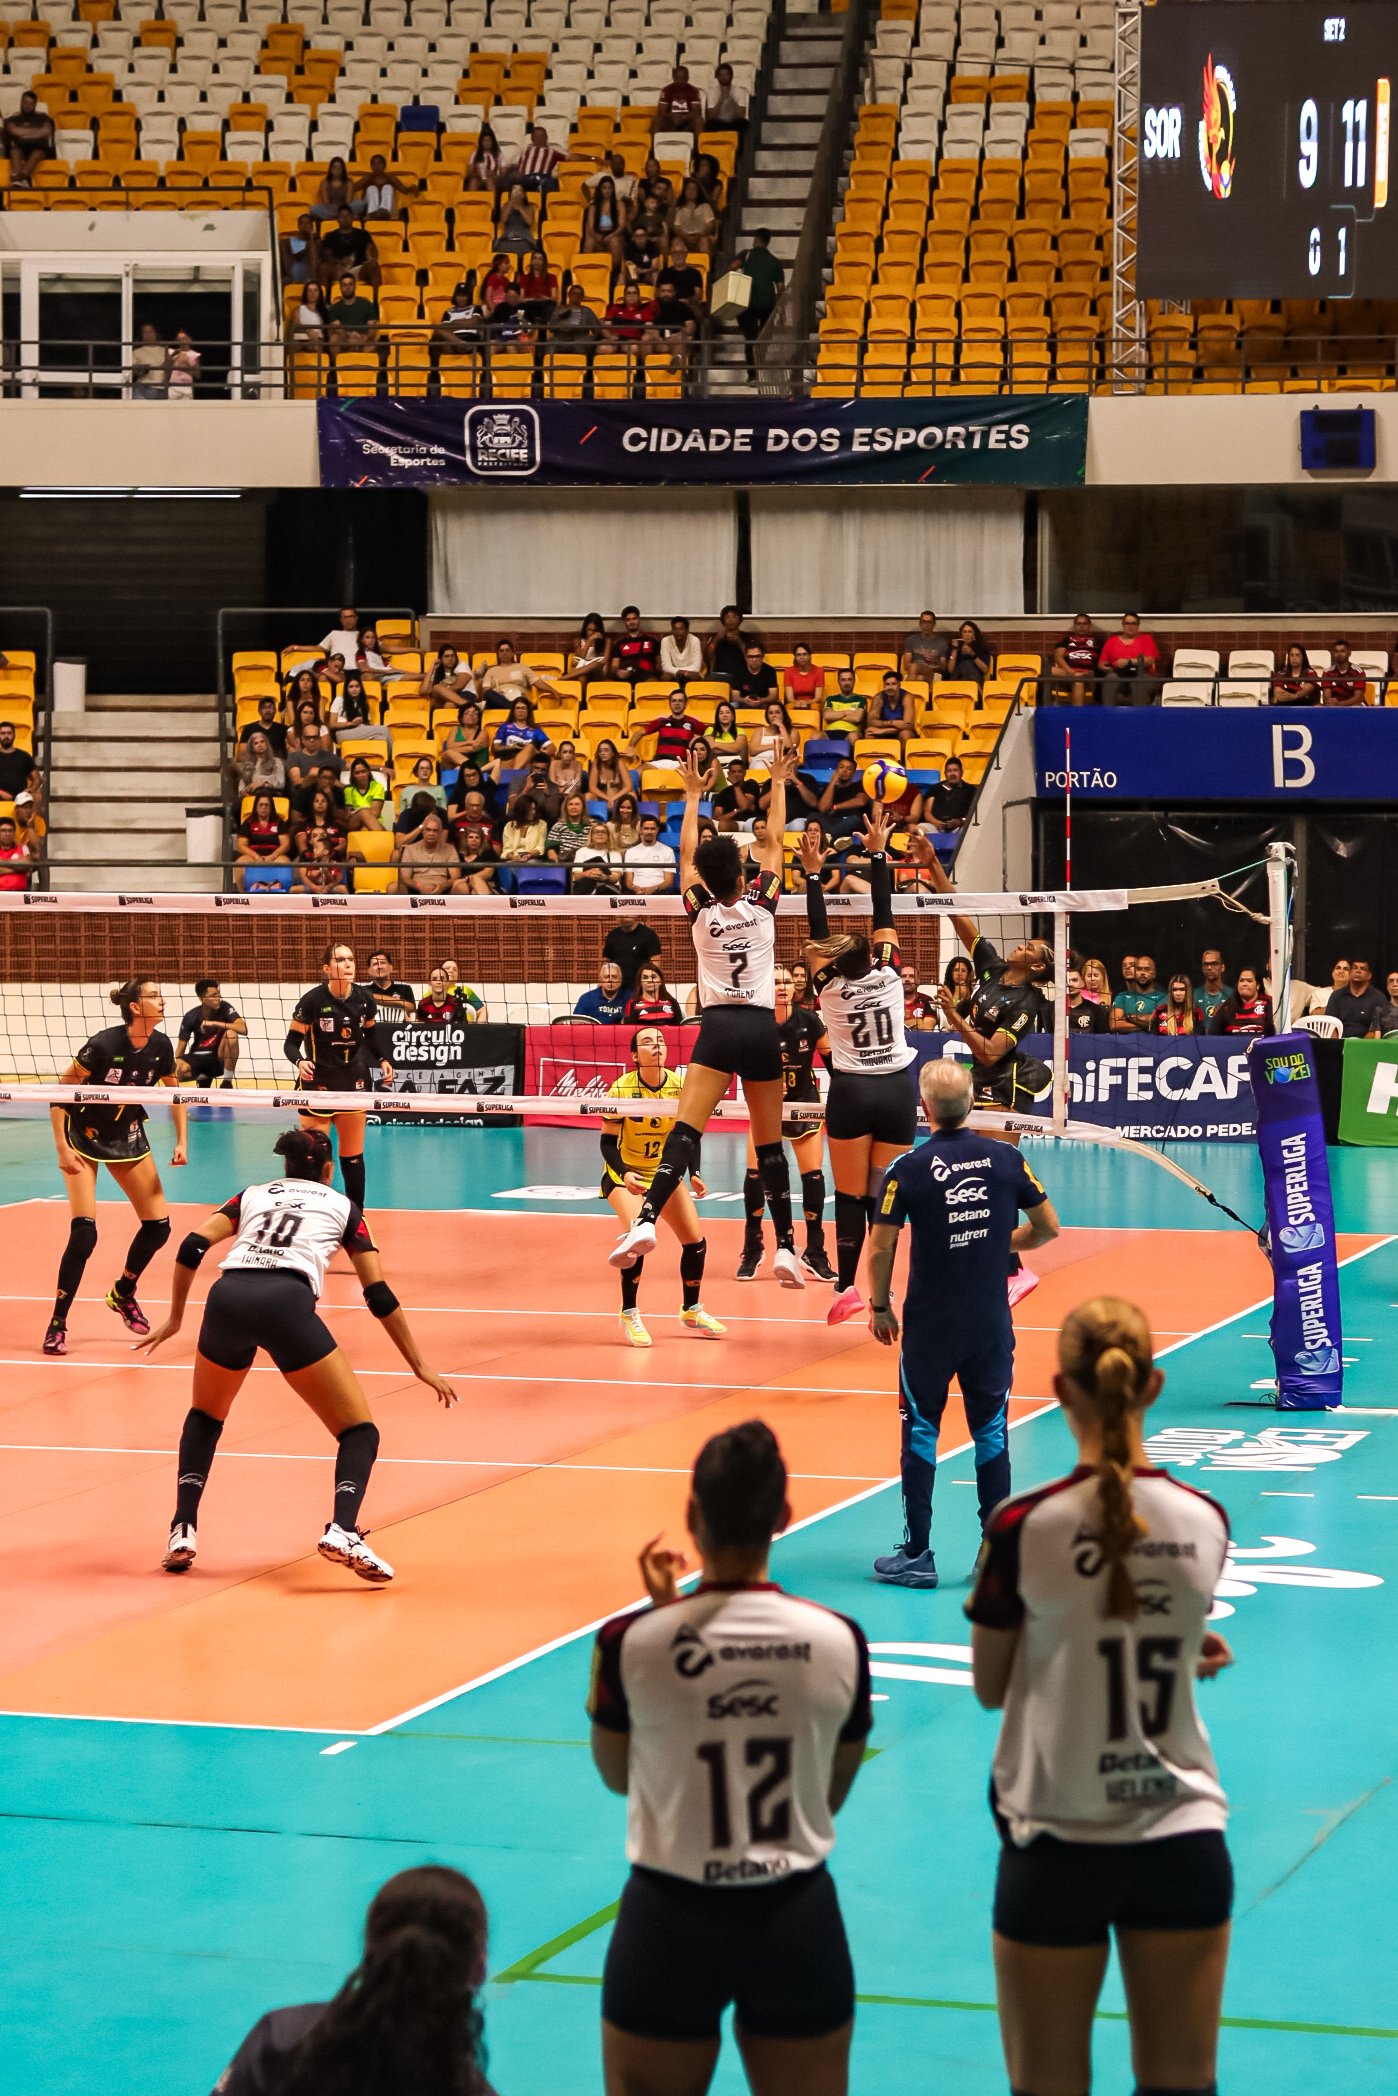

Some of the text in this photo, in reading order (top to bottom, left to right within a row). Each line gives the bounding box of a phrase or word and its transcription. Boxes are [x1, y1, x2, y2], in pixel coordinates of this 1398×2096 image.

[1144, 106, 1181, 158] SOR
[1299, 99, 1318, 188] 9
[1342, 99, 1367, 187] 11
[1338, 226, 1346, 276] 1
[622, 423, 1031, 453] CIDADE DOS ESPORTES
[362, 443, 445, 455] Secretaria de
[477, 449, 528, 462] RECIFE
[390, 456, 446, 468] Esportes
[1272, 724, 1316, 788] B
[1045, 768, 1117, 789] PORTÃO
[31, 896, 58, 904] SUPERLIGA
[127, 897, 153, 905] SUPERLIGA
[223, 898, 250, 906] SUPERLIGA
[320, 898, 347, 907] SUPERLIGA
[419, 899, 446, 907] SUPERLIGA
[518, 899, 546, 907] SUPERLIGA
[618, 899, 646, 908] SUPERLIGA
[825, 898, 850, 906] UPERLIGA
[925, 898, 954, 906] SUPERLIGA
[725, 919, 757, 931] everest
[729, 951, 748, 988] 7
[847, 1007, 893, 1048] 20
[392, 1024, 465, 1046] círculo
[344, 1049, 350, 1063] 1
[393, 1045, 462, 1066] design
[82, 1094, 109, 1102] SUPERLIGA
[181, 1096, 208, 1104] SUPERLIGA
[281, 1098, 308, 1107] SUPERLIGA
[382, 1101, 411, 1109] SUPERLIGA
[484, 1103, 513, 1112] SUPERLIGA
[588, 1106, 618, 1114] SUPERLIGA
[799, 1111, 825, 1120] SUPERLIG
[1013, 1123, 1043, 1133] SUPERLIGA
[1116, 1122, 1257, 1138] MERCADO PEDE.
[644, 1141, 661, 1159] 12
[951, 1157, 992, 1172] everest
[1281, 1133, 1316, 1226] SUPERLIGA
[948, 1208, 991, 1224] Betano
[255, 1212, 305, 1248] 10
[950, 1228, 989, 1243] nutren
[1296, 1262, 1332, 1350] SUPERLIGA
[719, 1643, 811, 1662] everest
[1097, 1636, 1184, 1742] 15
[697, 1736, 793, 1850] 12
